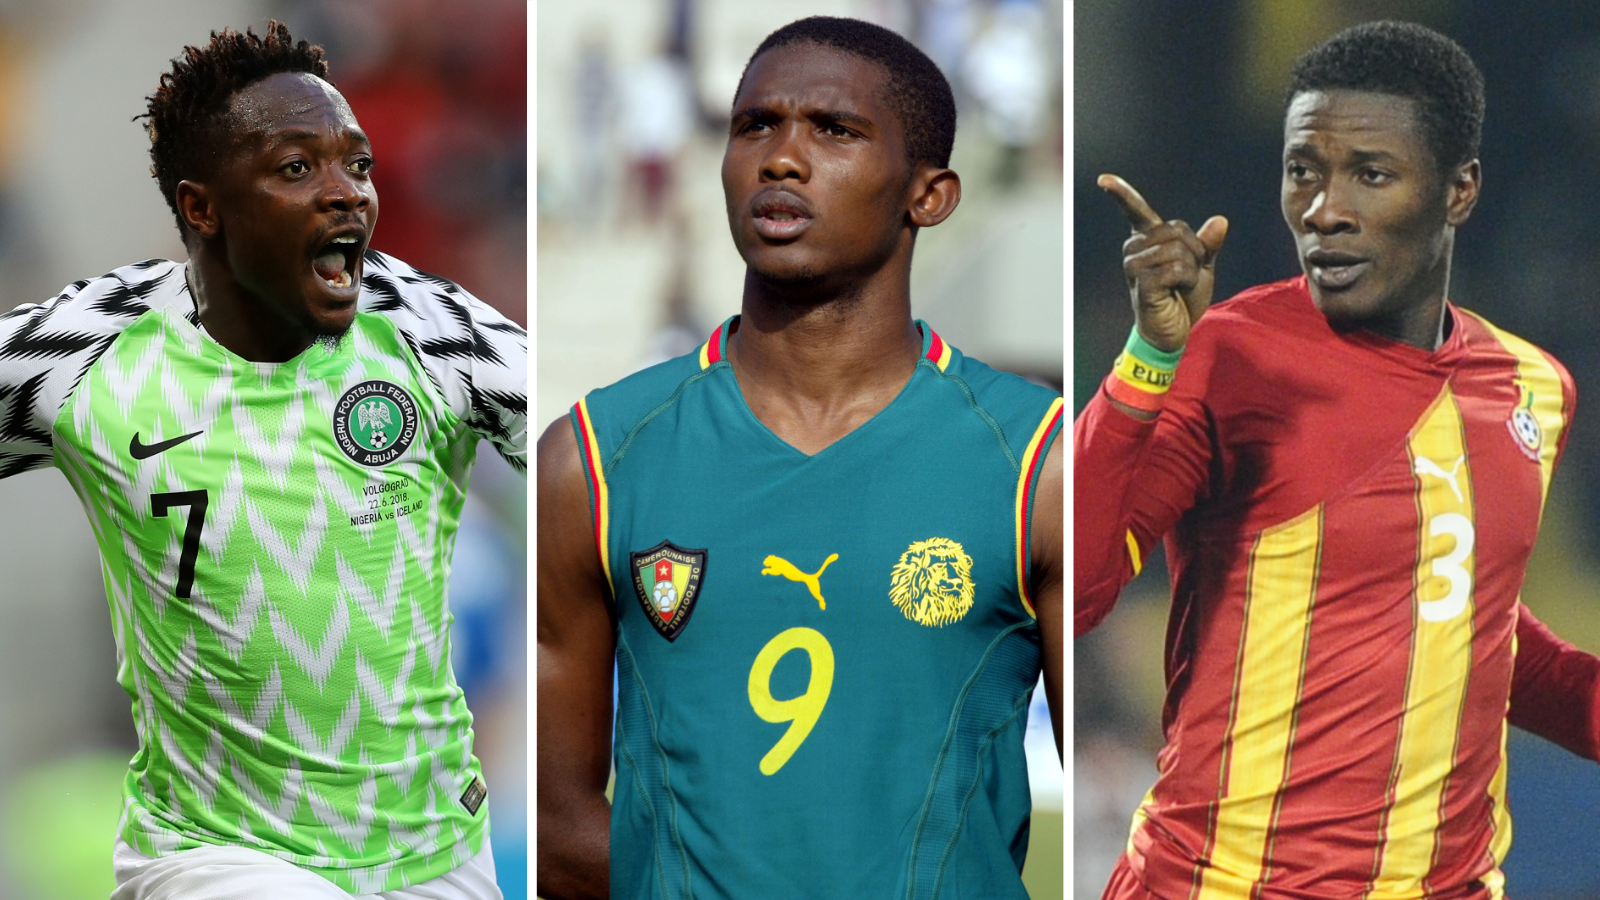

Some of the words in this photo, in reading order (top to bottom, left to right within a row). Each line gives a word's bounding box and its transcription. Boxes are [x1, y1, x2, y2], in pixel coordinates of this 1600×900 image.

[1132, 362, 1174, 387] ana
[338, 384, 385, 415] FOOTBALL
[387, 386, 415, 445] FEDERATION
[336, 416, 358, 456] NIGERIA
[364, 449, 399, 463] ABUJA
[362, 478, 409, 497] VOLGOGRAD
[350, 512, 383, 526] NIGERIA
[385, 512, 395, 520] vs
[396, 500, 423, 518] ICELAND
[150, 489, 209, 598] 7
[636, 549, 696, 567] CAMEROUNAISE
[690, 567, 700, 580] DE
[1420, 512, 1475, 622] 3
[635, 576, 668, 632] FEDERATION
[669, 584, 696, 630] FOOTBALL
[748, 627, 835, 776] 9
